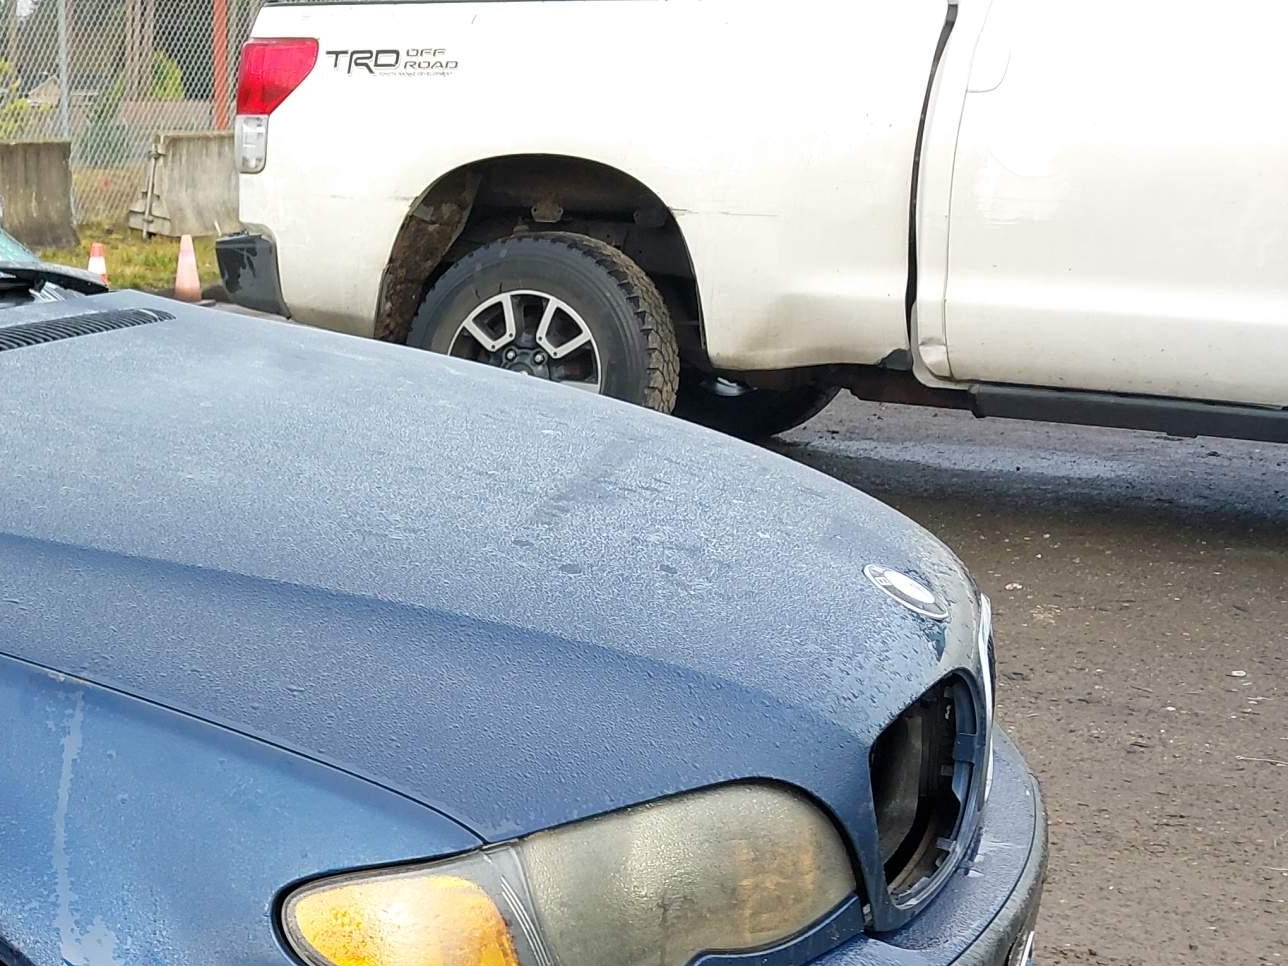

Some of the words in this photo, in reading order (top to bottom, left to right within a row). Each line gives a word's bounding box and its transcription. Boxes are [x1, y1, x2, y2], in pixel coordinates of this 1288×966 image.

[406, 48, 447, 57] OFF
[325, 49, 400, 74] TRD
[404, 60, 459, 69] ROAD
